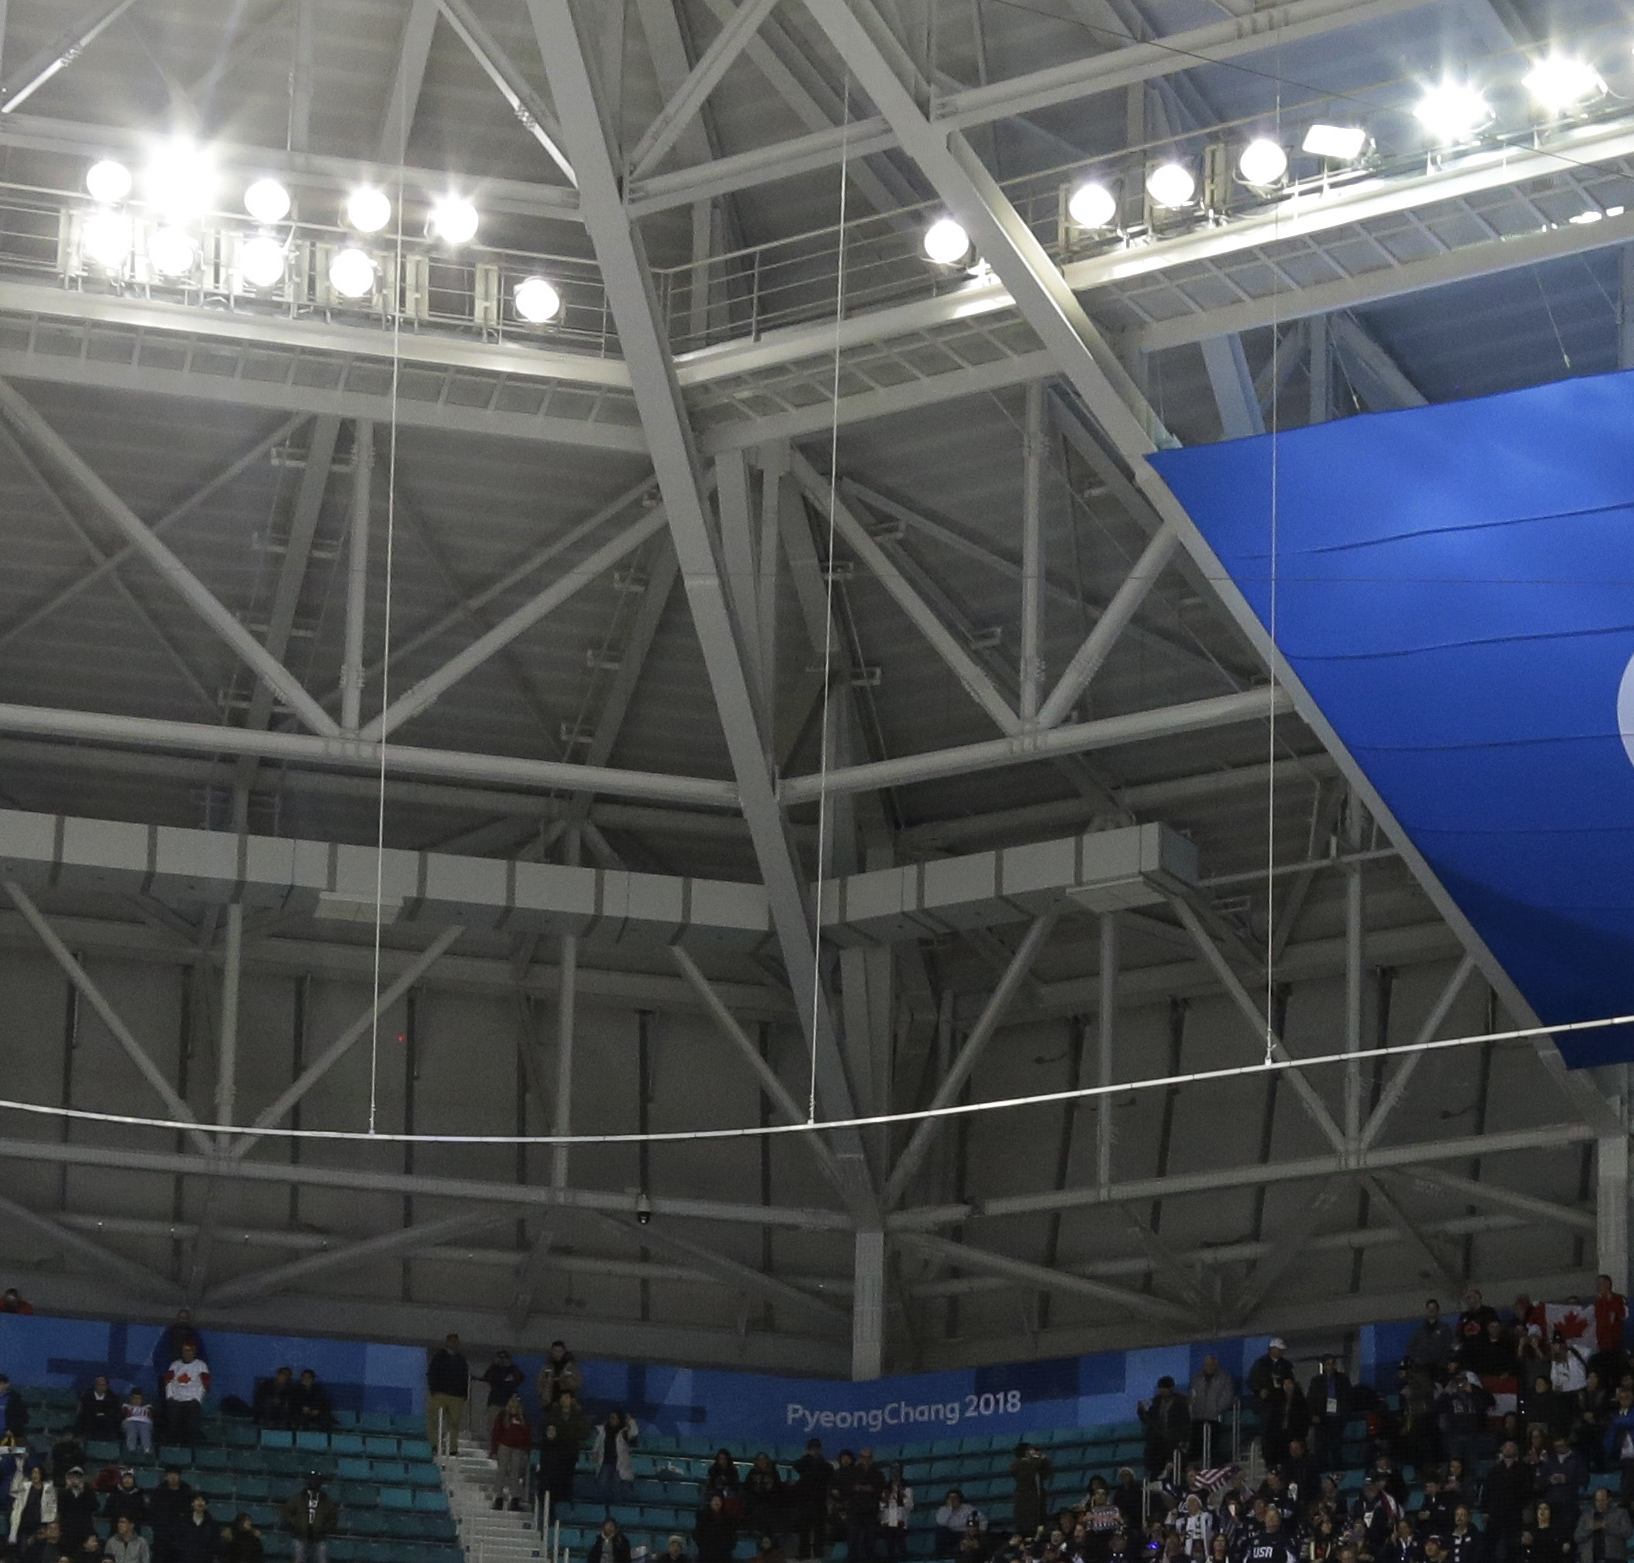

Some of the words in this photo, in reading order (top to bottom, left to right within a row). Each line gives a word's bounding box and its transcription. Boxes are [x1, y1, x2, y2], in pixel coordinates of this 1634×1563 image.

[786, 1401, 961, 1432] PyeongChang
[965, 1390, 1022, 1417] 2018
[1253, 1546, 1273, 1558] USA
